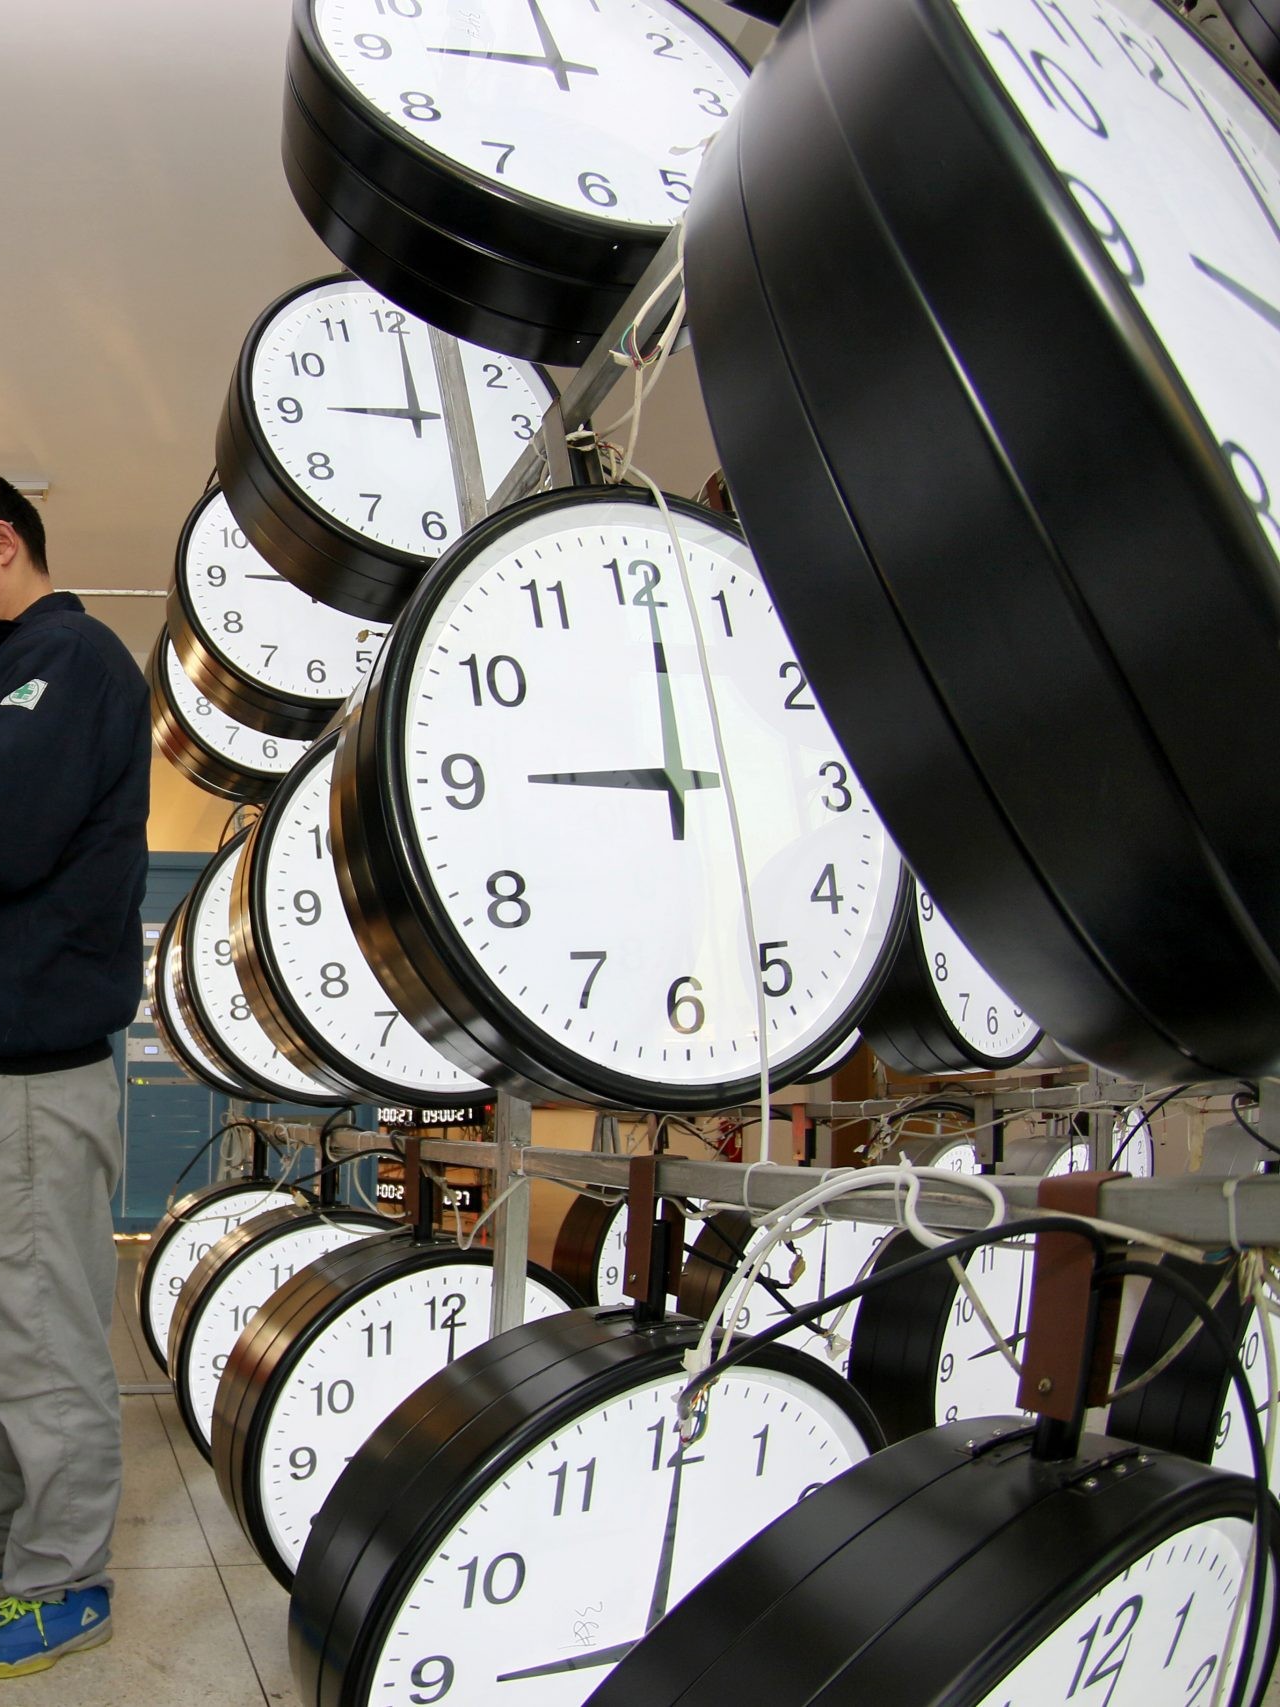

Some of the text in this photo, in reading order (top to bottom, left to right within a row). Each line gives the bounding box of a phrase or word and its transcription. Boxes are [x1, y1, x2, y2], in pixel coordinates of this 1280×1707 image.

[353, 33, 392, 60] 9
[646, 32, 683, 61] 2
[1093, 15, 1191, 111] 12
[986, 29, 1108, 139] 10
[400, 92, 441, 122] 8
[693, 87, 728, 118] 3
[481, 141, 515, 174] 7
[1222, 119, 1268, 194] 1
[578, 172, 618, 207] 6
[659, 169, 692, 204] 5
[1059, 171, 1144, 286] 9
[321, 318, 351, 344] 11
[370, 310, 411, 335] 12
[286, 351, 326, 378] 10
[483, 364, 508, 390] 2
[277, 397, 303, 423] 9
[511, 414, 536, 441] 3
[306, 452, 335, 480] 8
[359, 493, 382, 522] 7
[220, 526, 249, 550] 10
[421, 511, 448, 541] 6
[207, 564, 227, 587] 9
[603, 559, 668, 607] 12
[520, 579, 570, 630] 11
[711, 590, 734, 637] 1
[223, 610, 244, 634] 8
[260, 644, 279, 668] 7
[355, 650, 374, 675] 5
[306, 659, 327, 684] 6
[459, 653, 528, 708] 10
[778, 661, 815, 710] 2
[196, 695, 212, 715] 8
[225, 725, 240, 745] 7
[262, 739, 279, 759] 6
[440, 753, 485, 811] 9
[818, 762, 852, 812] 3
[485, 869, 531, 929] 8
[810, 863, 844, 915] 4
[294, 890, 322, 926] 9
[920, 892, 934, 922] 9
[214, 939, 232, 965] 9
[935, 953, 948, 981] 8
[320, 962, 349, 999] 8
[569, 951, 607, 1009] 7
[758, 940, 793, 998] 5
[230, 994, 252, 1020] 8
[665, 976, 706, 1035] 6
[959, 993, 970, 1022] 7
[373, 1010, 400, 1047] 7
[987, 1007, 999, 1035] 6
[188, 1242, 211, 1261] 10
[980, 1246, 994, 1274] 11
[169, 1277, 184, 1296] 9
[270, 1264, 294, 1290] 11
[606, 1266, 618, 1285] 9
[424, 1293, 467, 1331] 12
[736, 1307, 751, 1329] 9
[954, 1297, 974, 1326] 10
[360, 1321, 393, 1358] 11
[940, 1353, 954, 1383] 9
[310, 1379, 354, 1417] 10
[1215, 1411, 1231, 1449] 9
[289, 1447, 317, 1481] 9
[752, 1423, 770, 1477] 1
[548, 1457, 597, 1517] 11
[457, 1552, 527, 1610] 10
[1163, 1591, 1195, 1670] 1
[1066, 1594, 1144, 1700] 12
[410, 1655, 455, 1705] 9
